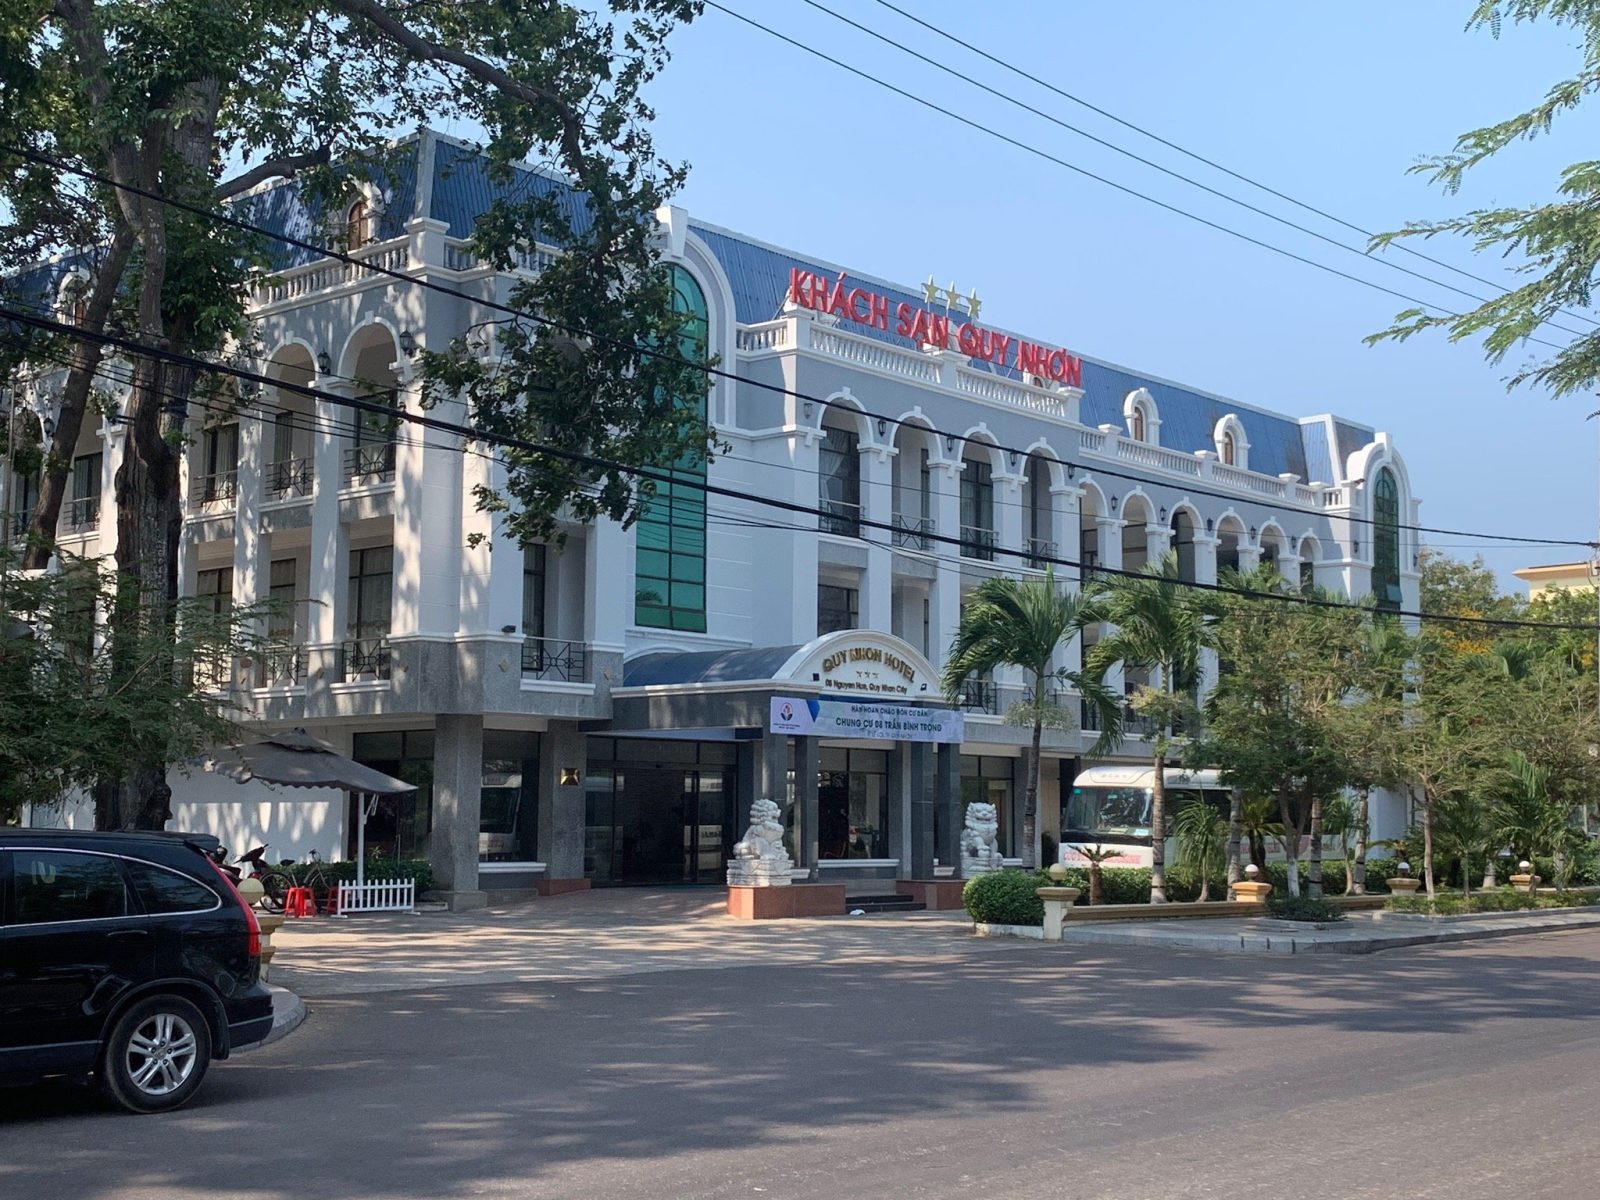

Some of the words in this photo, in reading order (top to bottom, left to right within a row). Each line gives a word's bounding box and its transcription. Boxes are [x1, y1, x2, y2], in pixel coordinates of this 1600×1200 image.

[789, 266, 888, 331] KHÁCH
[896, 302, 950, 350] SẠN
[956, 322, 1011, 367] QUY
[1017, 339, 1083, 388] NHƠN
[822, 649, 848, 672] QUY
[883, 652, 916, 683] HOTEL
[869, 683, 881, 692] Quy
[896, 685, 908, 695] City
[835, 717, 861, 728] CHUNG
[863, 718, 873, 728] CƯ
[920, 722, 942, 733] TRỌNG
